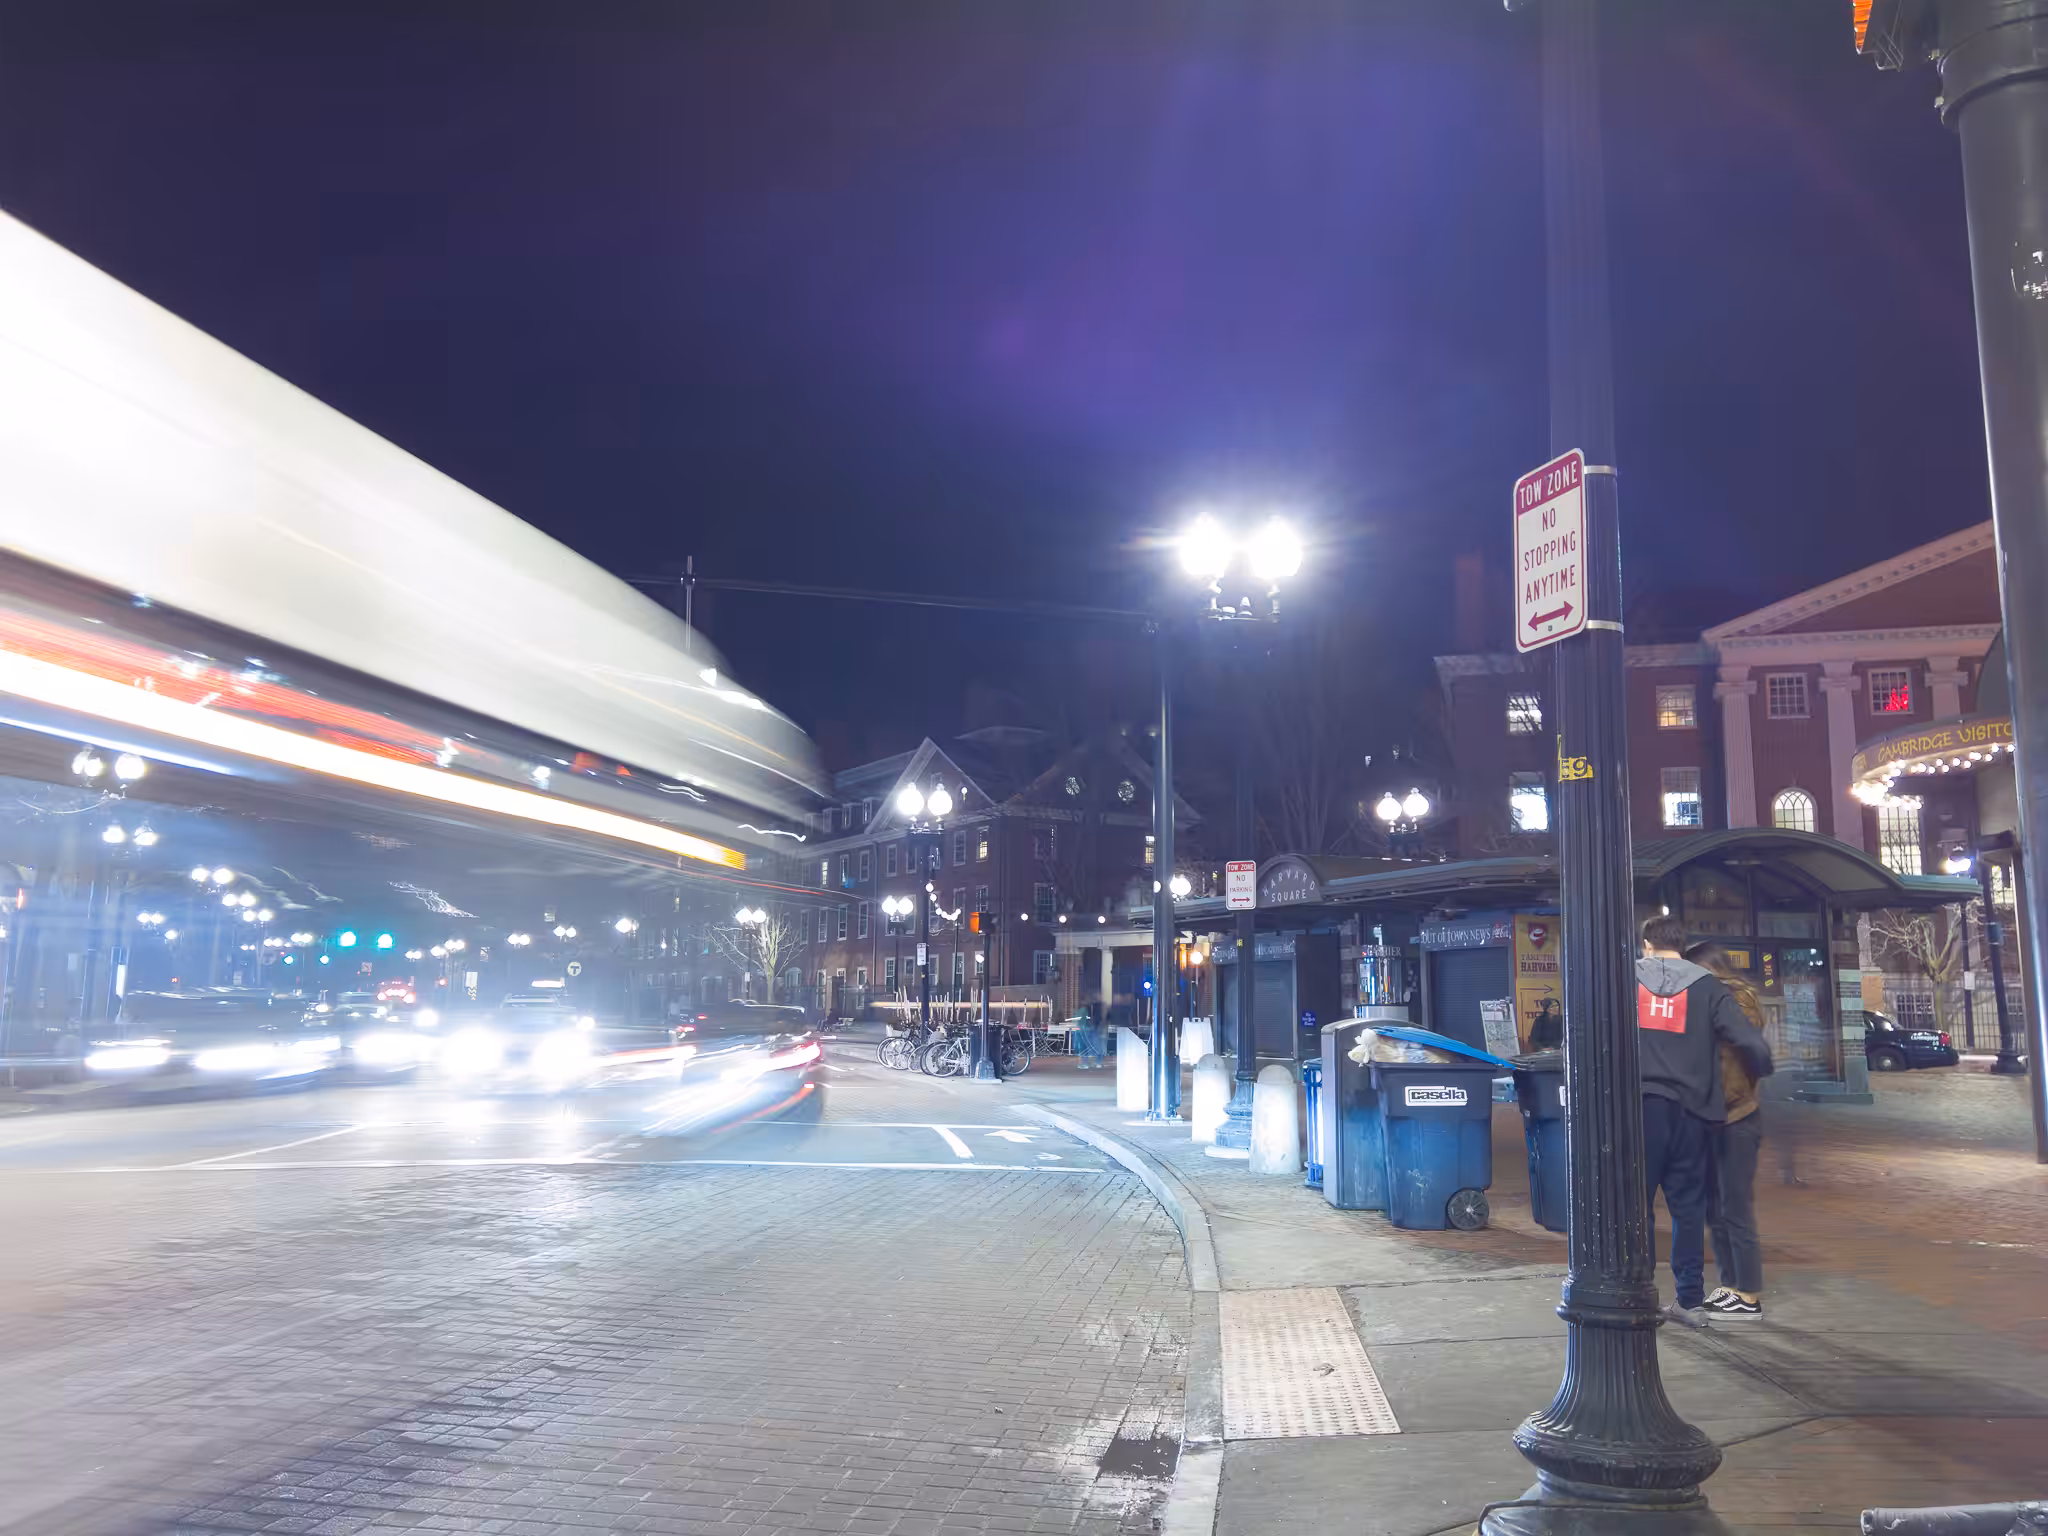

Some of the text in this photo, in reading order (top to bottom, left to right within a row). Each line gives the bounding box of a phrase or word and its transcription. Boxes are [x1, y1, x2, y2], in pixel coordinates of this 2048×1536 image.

[1520, 460, 1578, 509] TOW ZONE
[1542, 508, 1556, 532] NO
[1524, 530, 1576, 572] STOPPING
[1526, 564, 1576, 605] ANYTIME
[1878, 731, 1953, 763] CAMBRIDGE
[1240, 863, 1254, 871] ZONE
[1236, 874, 1246, 882] NO
[1262, 868, 1316, 897] HARVARD
[1230, 886, 1253, 894] PARKING
[1271, 888, 1307, 903] SQUARE
[1469, 927, 1491, 941] NEWS
[1521, 962, 1559, 972] HARVARD
[1650, 995, 1674, 1018] Hi
[1411, 1089, 1466, 1100] casella
